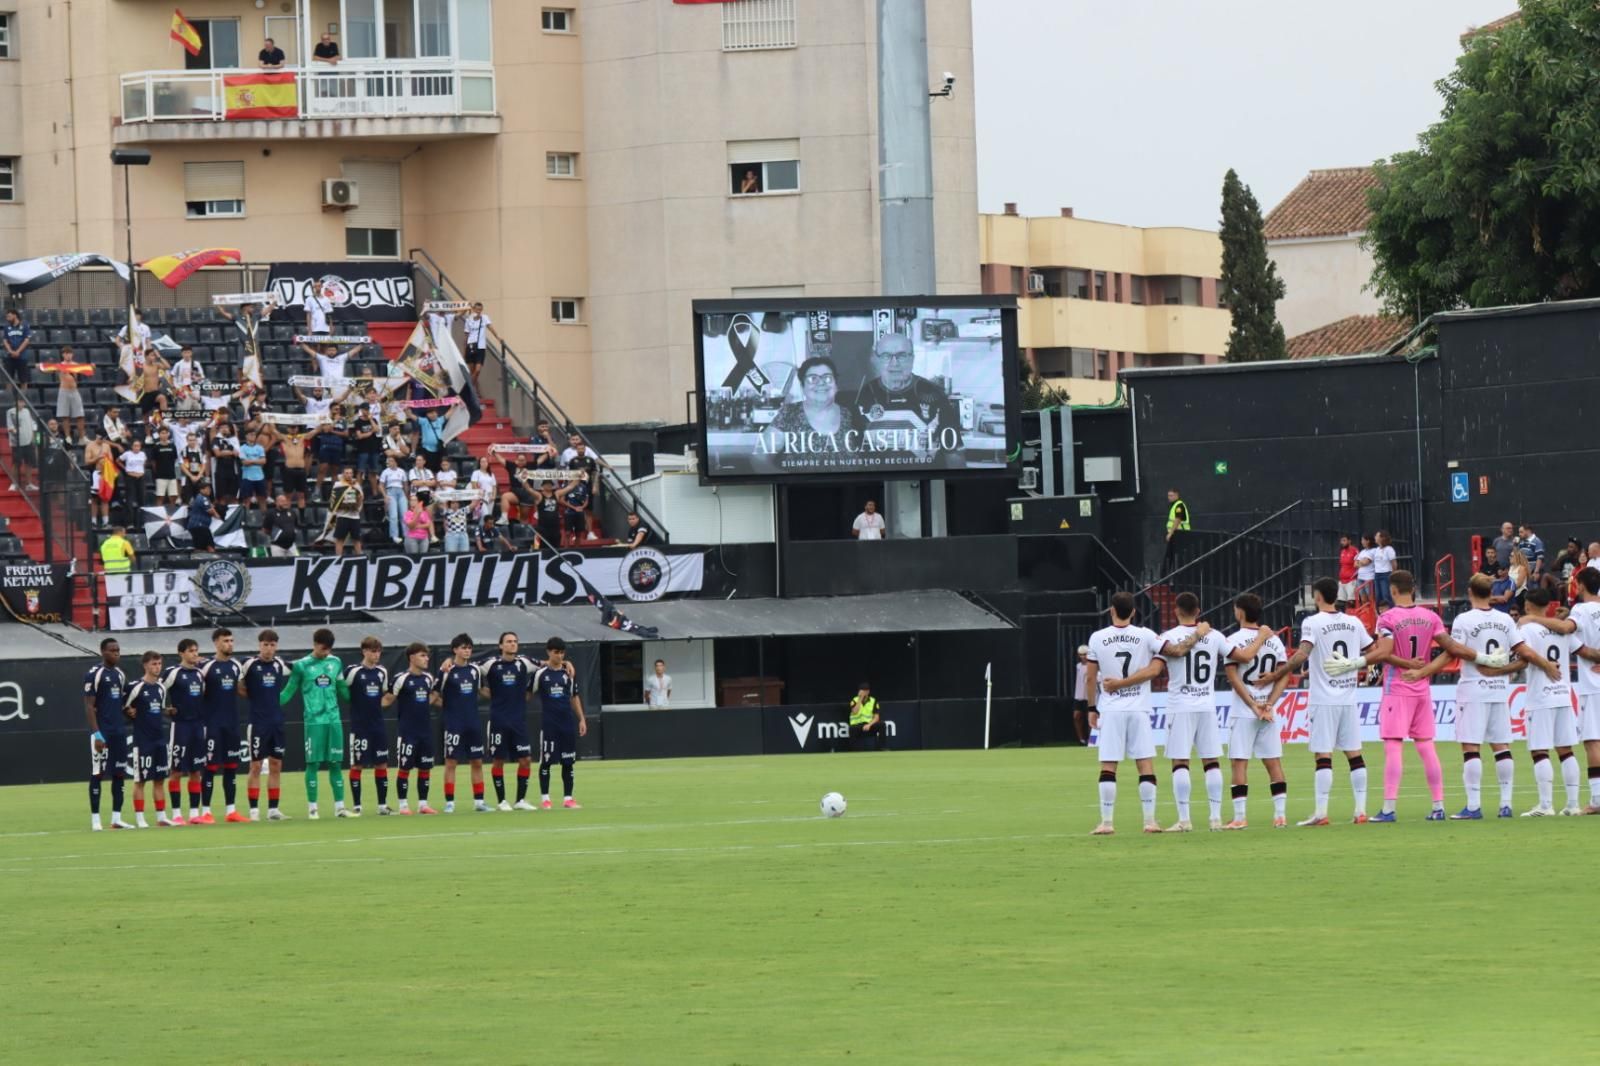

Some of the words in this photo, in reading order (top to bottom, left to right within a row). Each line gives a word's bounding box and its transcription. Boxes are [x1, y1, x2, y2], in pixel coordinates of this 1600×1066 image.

[353, 276, 415, 308] SUR
[781, 459, 820, 468] SIEMPRE
[824, 459, 836, 467] EN
[839, 457, 881, 467] NUESTRO
[885, 456, 933, 466] RECUERDO
[5, 564, 53, 576] FRENTE
[3, 576, 54, 587] KETAMA
[287, 552, 584, 612] KABALLAS
[1102, 635, 1141, 647] CAMACHO
[1114, 651, 1132, 680] 7
[1185, 650, 1211, 685] 16
[1242, 653, 1277, 686] 20
[207, 739, 215, 752] 9
[354, 739, 368, 751] 29
[447, 733, 460, 746] 20
[490, 733, 502, 745] 18
[172, 745, 186, 758] 21
[401, 743, 413, 756] 16
[140, 756, 152, 768] 10
